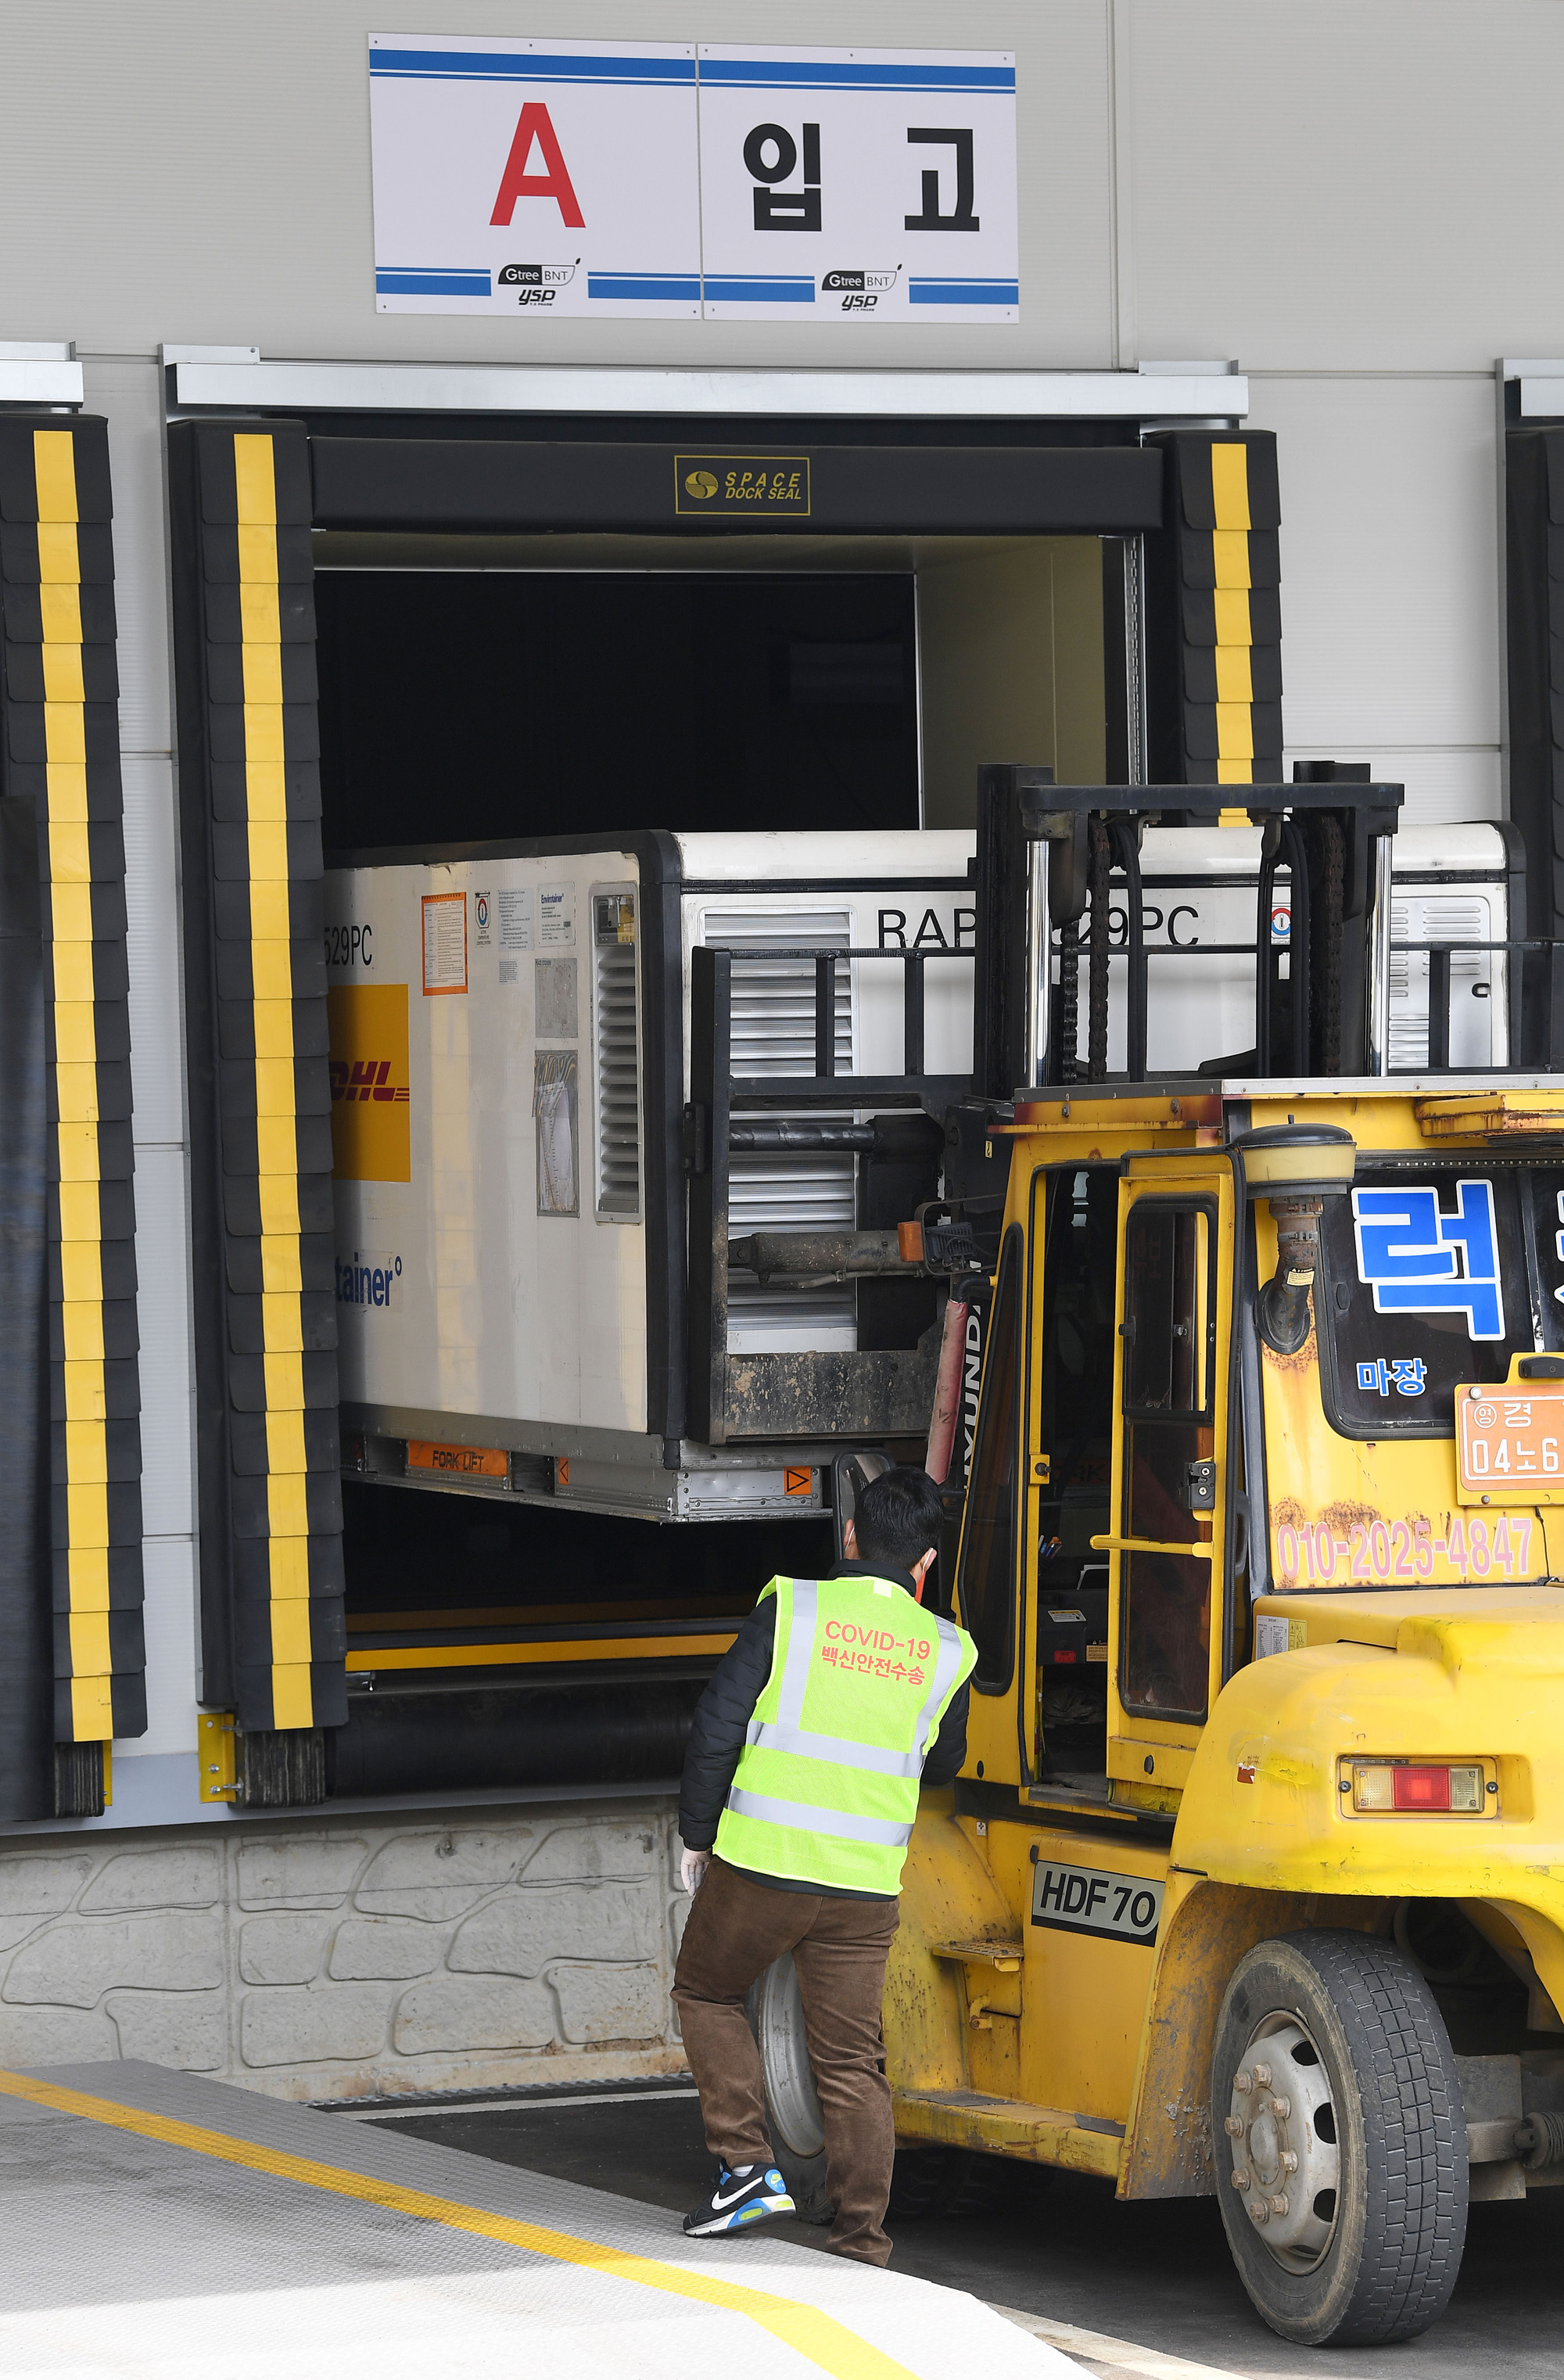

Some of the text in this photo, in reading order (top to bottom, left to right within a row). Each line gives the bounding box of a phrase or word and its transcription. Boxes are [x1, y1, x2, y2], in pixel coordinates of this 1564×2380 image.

[489, 102, 586, 228] A
[544, 271, 569, 281] BNT
[866, 276, 890, 286] BNT
[725, 472, 802, 487] SPACE
[725, 487, 802, 500] DOCK SEAL
[1356, 1358, 1426, 1397] 마장
[432, 1450, 484, 1472] FORK LIFT
[1277, 1518, 1533, 1580] 010-2025-4847
[825, 1620, 931, 1660] COVID-19
[821, 1646, 926, 1685] 백신안전수송
